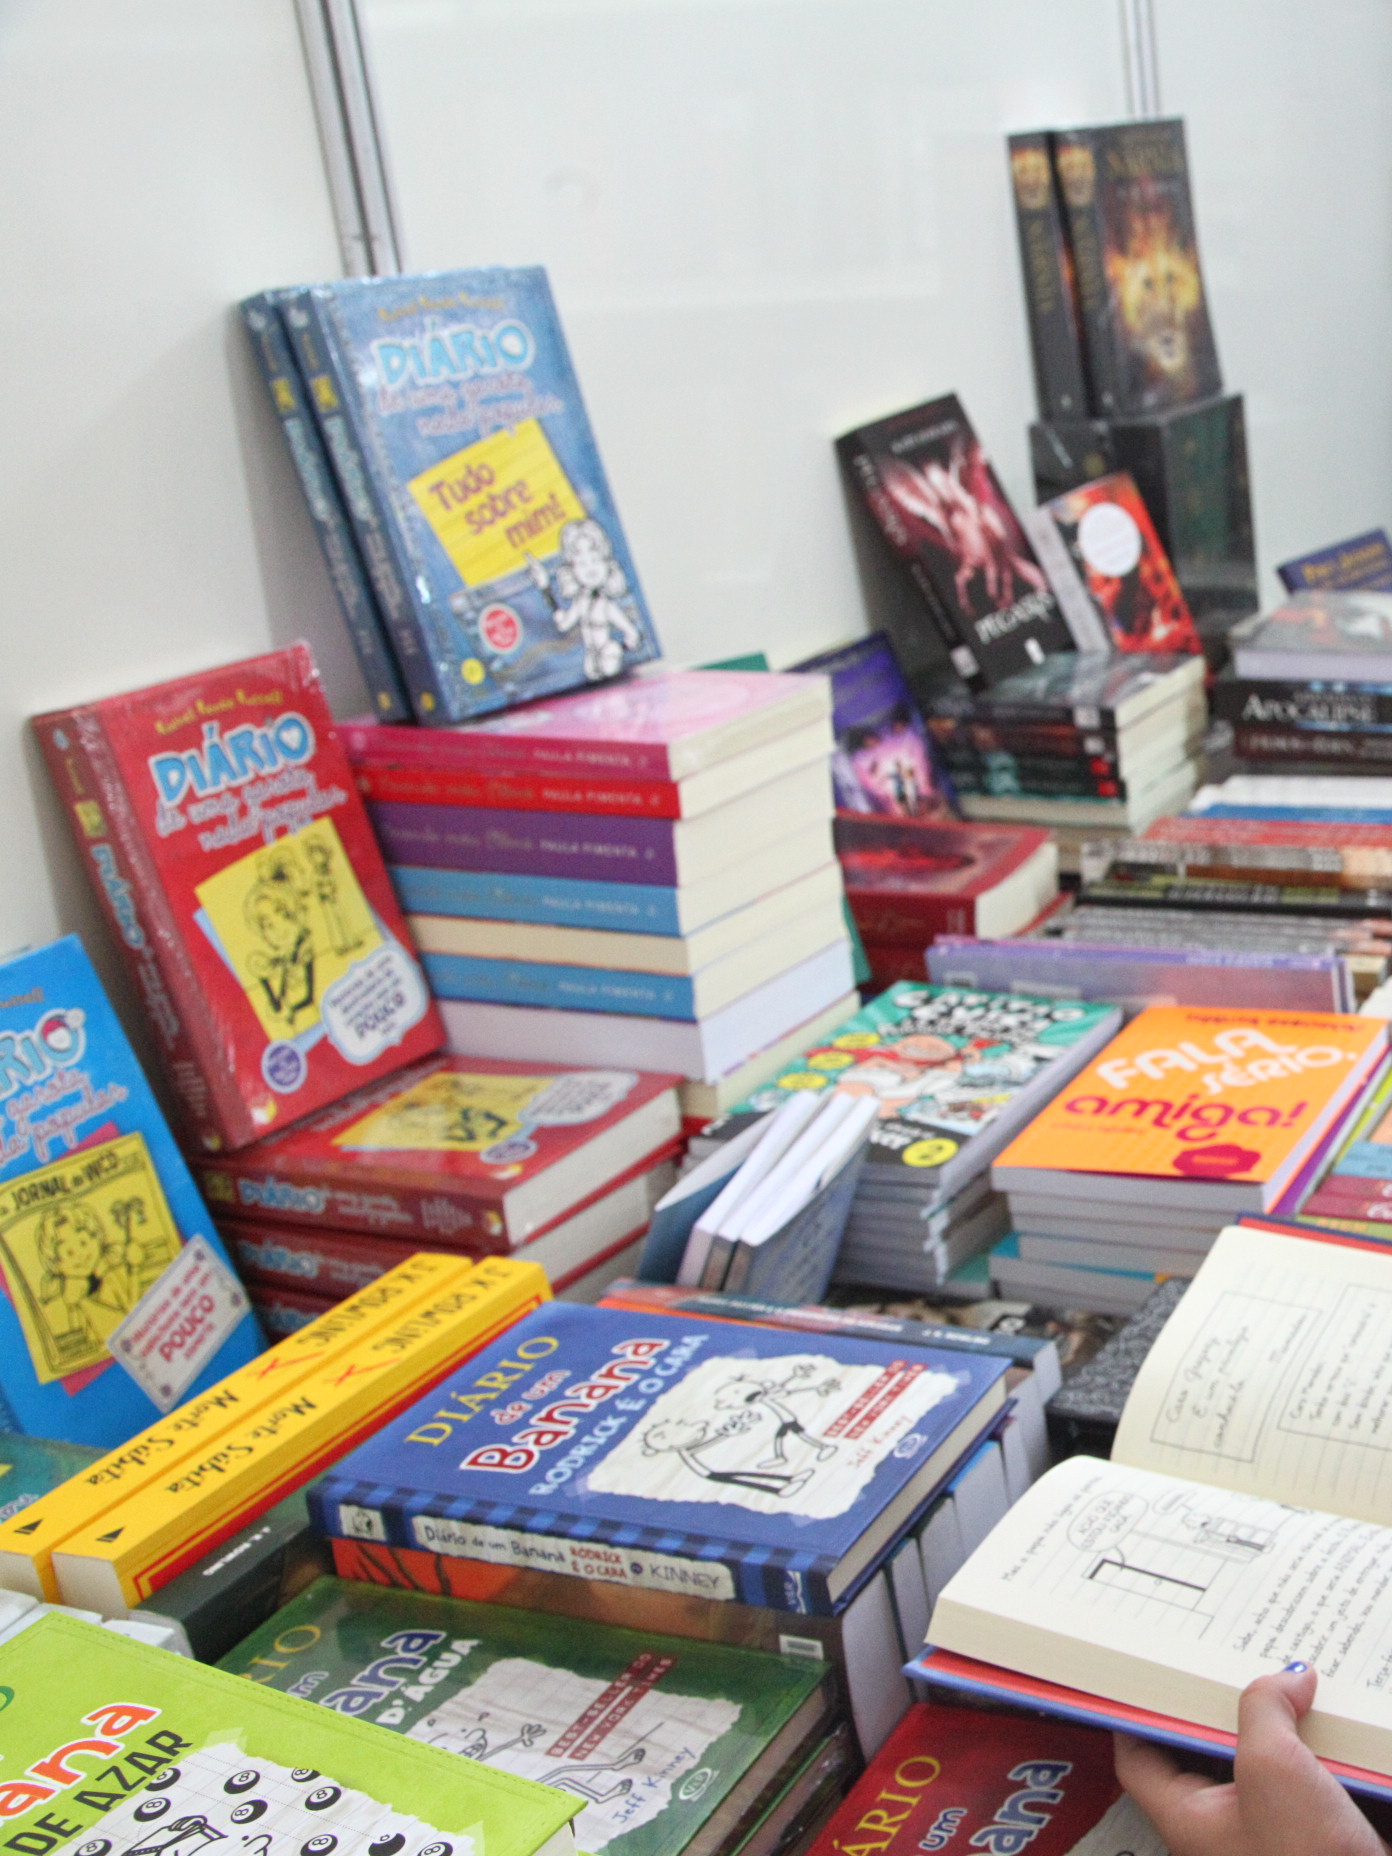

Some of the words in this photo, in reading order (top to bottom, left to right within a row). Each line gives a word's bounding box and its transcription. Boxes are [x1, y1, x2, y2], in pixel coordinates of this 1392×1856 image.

[373, 317, 534, 387] DIÁRIO
[429, 463, 496, 512] Tudo
[465, 480, 533, 535] sobre
[505, 492, 567, 549] mim!
[149, 713, 314, 804] DIÁRIO
[92, 844, 146, 950] DIÁRIO
[1096, 1027, 1298, 1090] FALA
[1064, 1092, 1310, 1142] amiga!
[12, 1176, 71, 1211] JORNAL
[238, 1174, 328, 1215] DIÁRIO
[150, 1294, 215, 1363] POUCO
[173, 1389, 239, 1432] Morte
[249, 1396, 317, 1438] Morte
[403, 1336, 559, 1447] DIÁRIO
[460, 1338, 671, 1475] Banana
[489, 1400, 533, 1426] de
[521, 1369, 572, 1400] um
[528, 1414, 627, 1496] RODRICK
[613, 1395, 646, 1412] É
[637, 1378, 665, 1394] O
[655, 1333, 710, 1378] CARA
[86, 1435, 175, 1485] Súbita
[167, 1443, 254, 1492] Súbita
[424, 1524, 466, 1547] Diário
[472, 1537, 485, 1549] de
[488, 1541, 507, 1551] um
[511, 1541, 566, 1563] Banana
[649, 1563, 720, 1590] KINNEY
[570, 1546, 622, 1565] RODRICK
[583, 1564, 595, 1575] O
[596, 1565, 628, 1579] CARA
[375, 1639, 482, 1726] D'ÁGUA
[1321, 1658, 1341, 1678] ficar
[549, 1671, 634, 1756] BEST-SELLER
[632, 1653, 652, 1670] DO
[574, 1733, 602, 1760] NEW
[601, 1698, 636, 1730] YORK
[632, 1657, 674, 1693] TIMES
[3, 1811, 85, 1856] DE
[72, 1728, 194, 1813] AZAR
[612, 1791, 647, 1825] Jeff
[641, 1745, 698, 1790] Kinney
[918, 1807, 967, 1851] um
